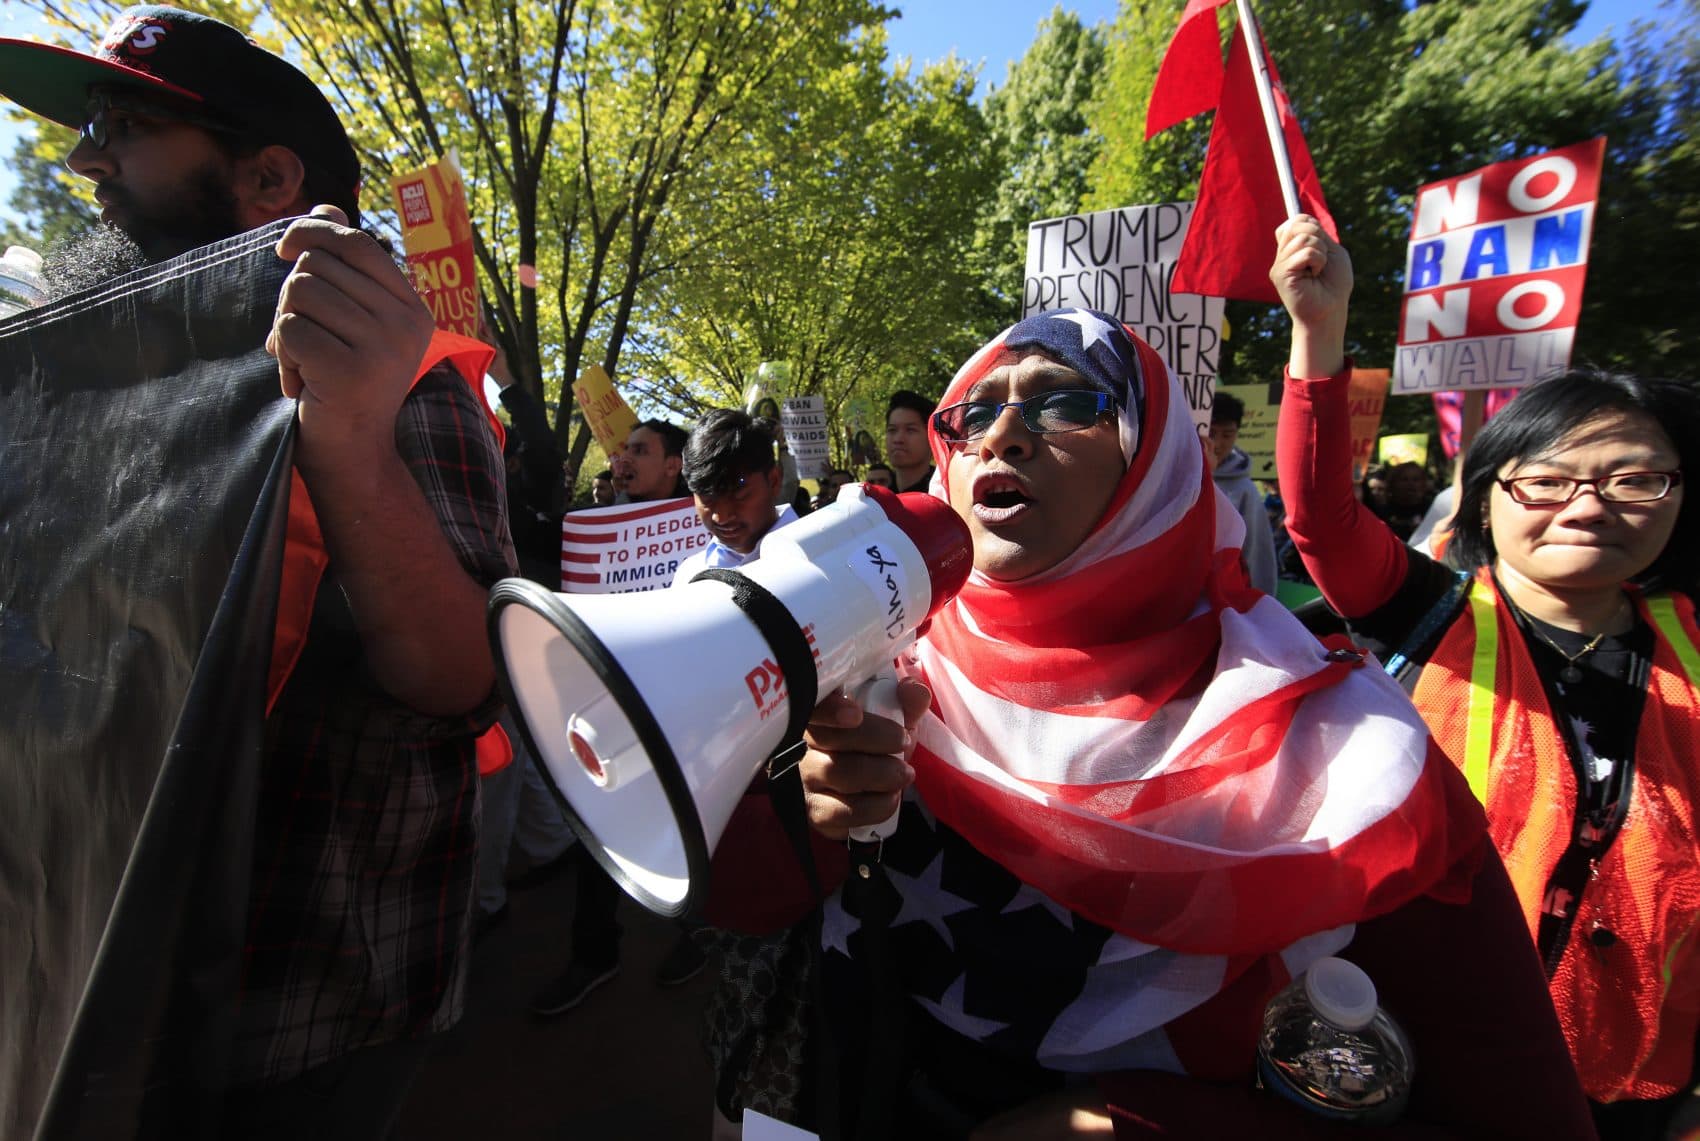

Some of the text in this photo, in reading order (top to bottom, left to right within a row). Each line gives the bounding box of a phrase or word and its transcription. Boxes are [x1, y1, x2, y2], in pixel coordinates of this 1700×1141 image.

[1415, 156, 1577, 239] NO
[1031, 203, 1191, 272] TRUMP'
[1409, 208, 1584, 291] BAN
[415, 256, 462, 292] NO
[420, 287, 478, 321] MUS
[1403, 280, 1565, 343] NO
[1400, 332, 1567, 390] WALL
[1183, 374, 1215, 411] NTS
[624, 514, 703, 542] I PLEDGE
[606, 558, 681, 584] IMMIGR
[607, 550, 629, 564] TO
